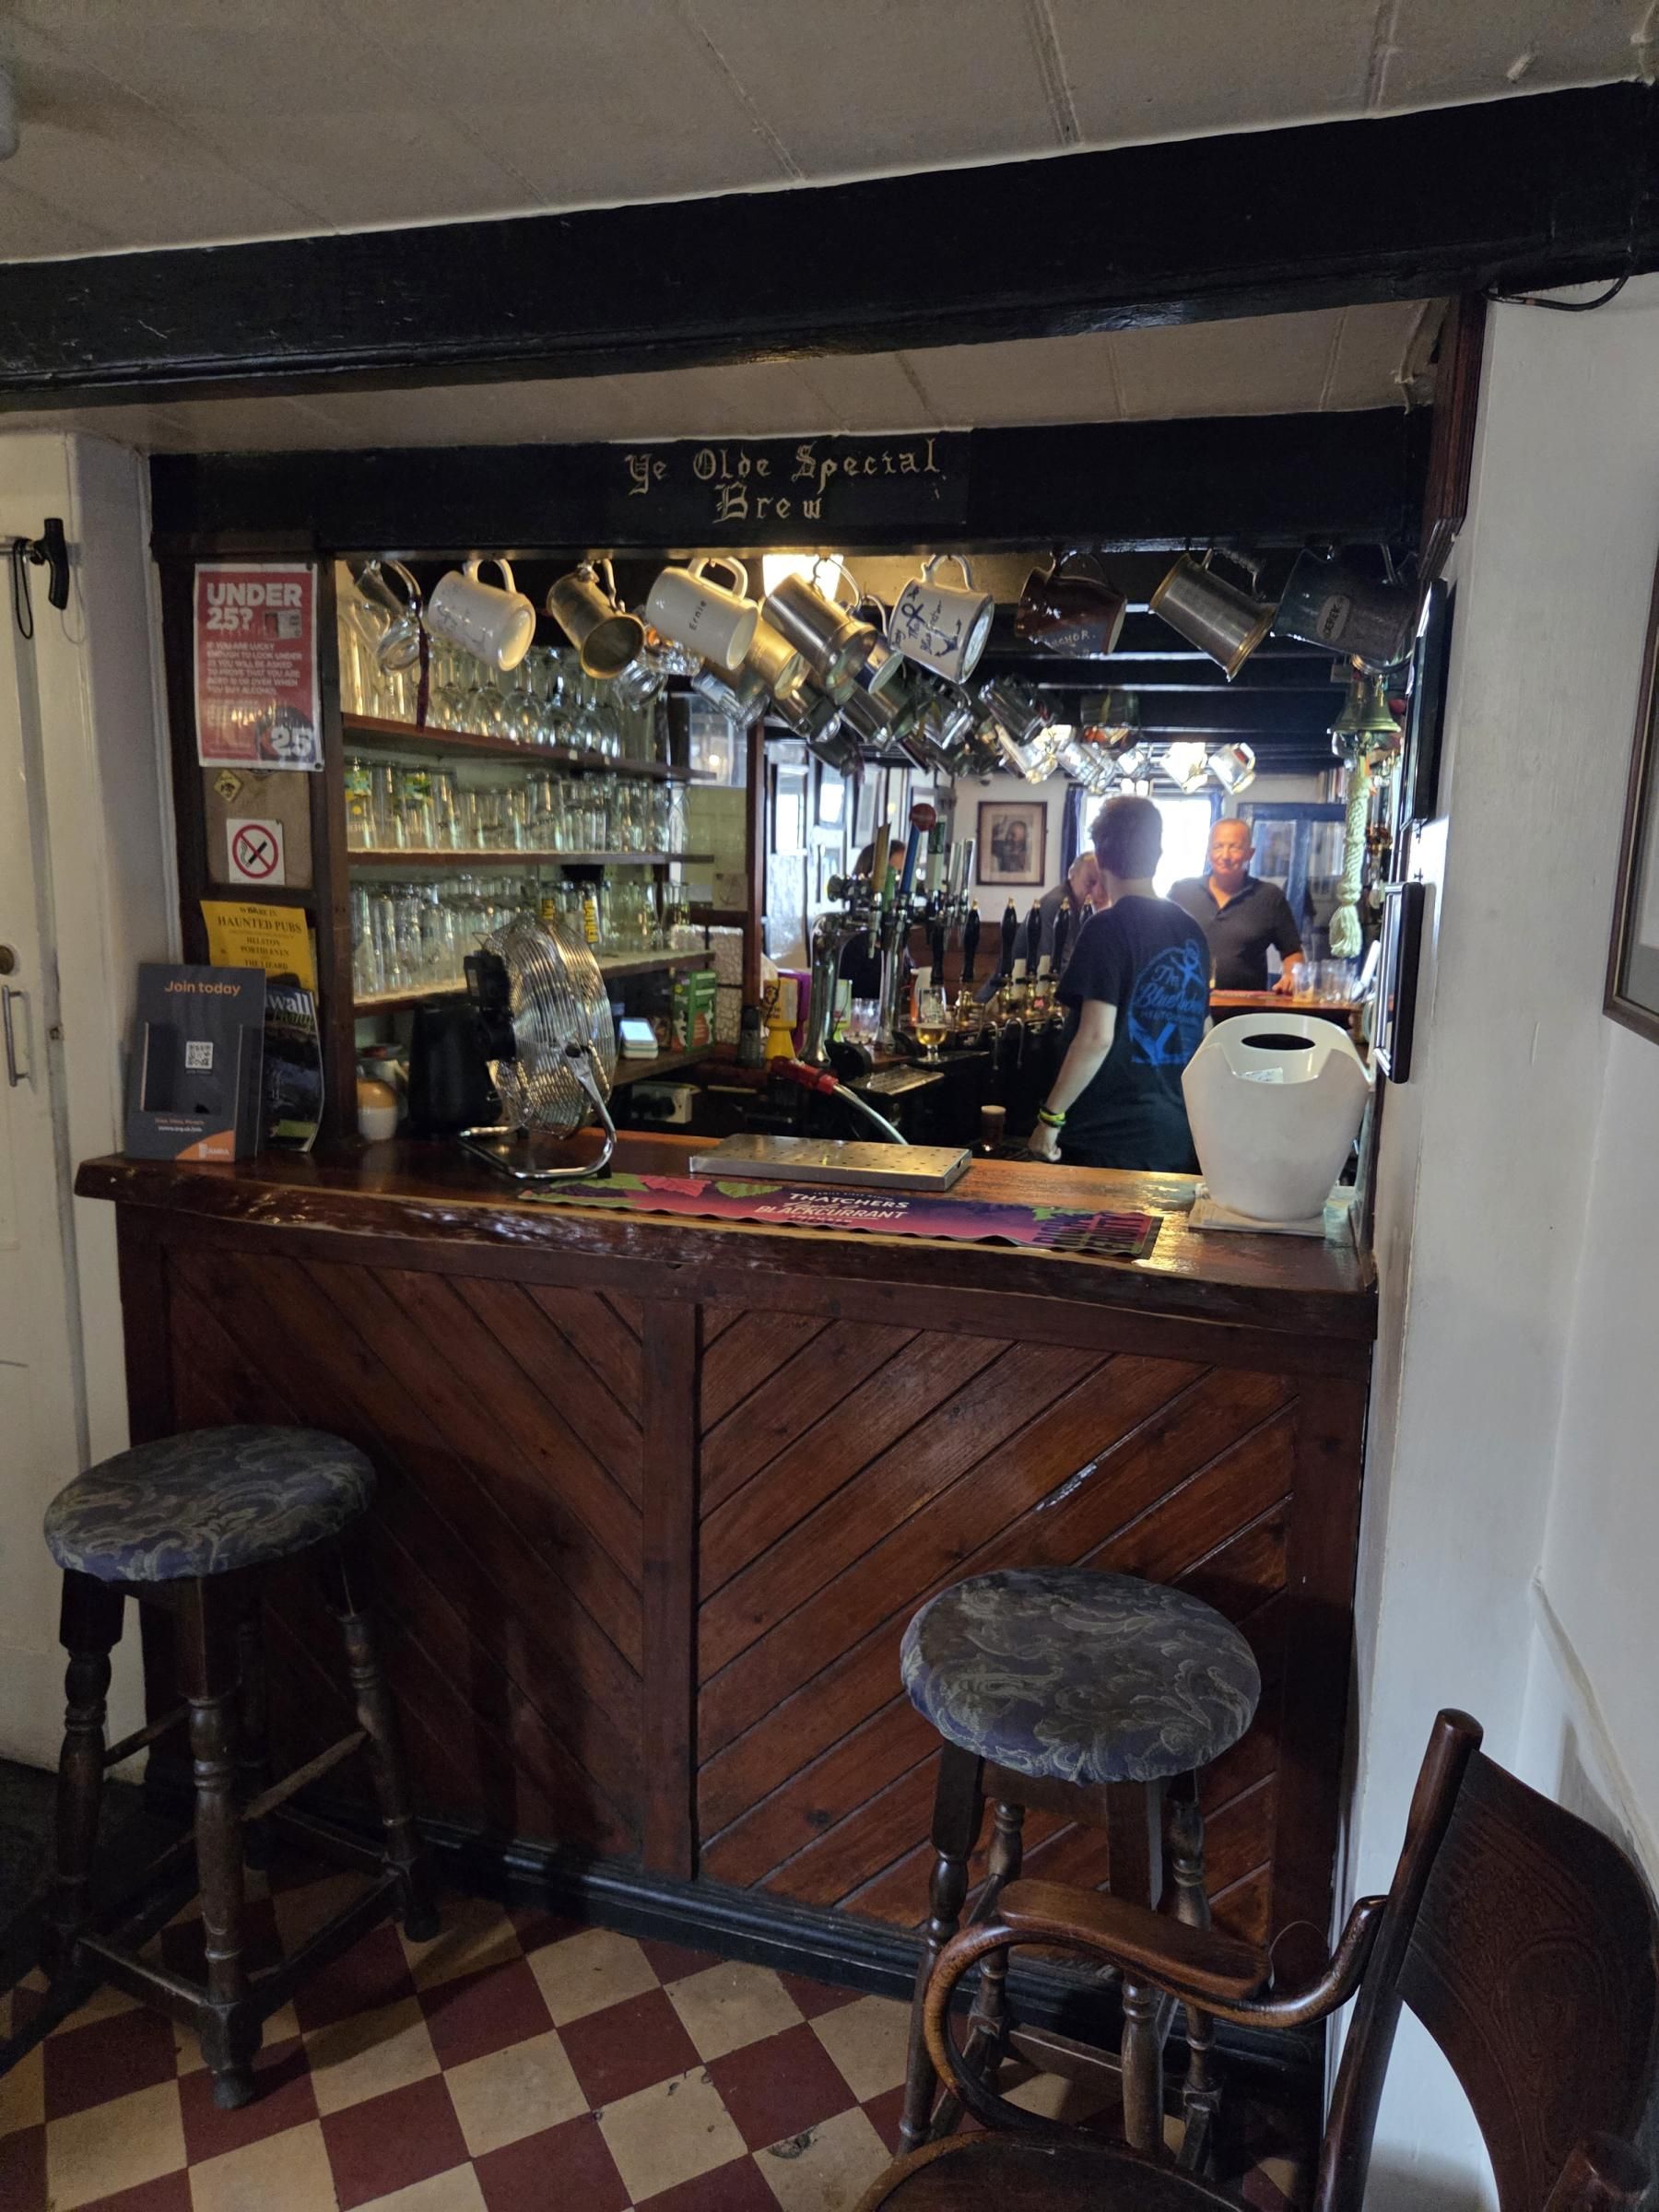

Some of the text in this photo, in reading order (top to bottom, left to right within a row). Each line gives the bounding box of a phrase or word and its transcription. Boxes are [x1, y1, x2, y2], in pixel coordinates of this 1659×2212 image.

[625, 437, 941, 495] Ye Olde Special
[712, 481, 826, 524] Brew
[206, 582, 302, 607] UNDER
[206, 606, 253, 630] 25?
[688, 600, 707, 630] Ernie
[271, 727, 313, 757] 25
[218, 916, 302, 933] HAUNTED PUBS
[164, 980, 241, 997] Join today
[265, 992, 311, 1016] wall
[755, 1205, 909, 1219] BLACKCURRANT
[790, 1193, 910, 1208] THATCHERS
